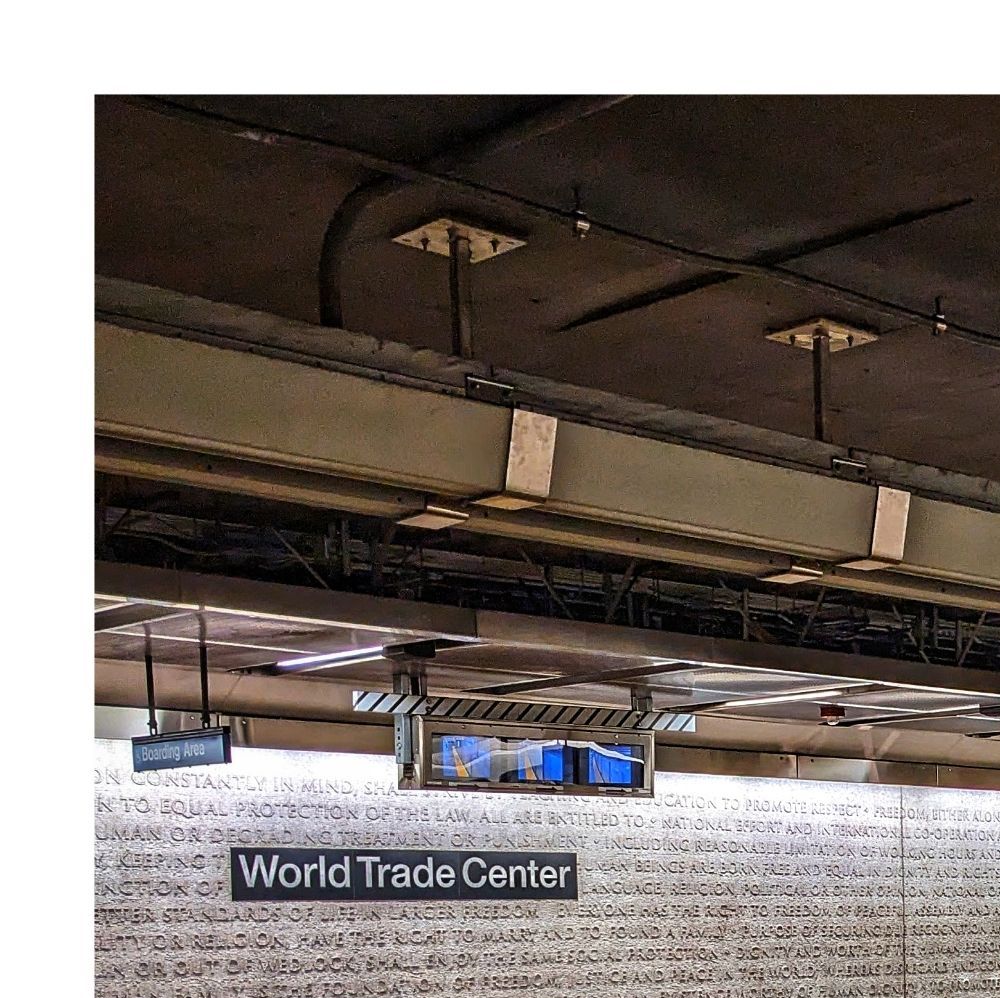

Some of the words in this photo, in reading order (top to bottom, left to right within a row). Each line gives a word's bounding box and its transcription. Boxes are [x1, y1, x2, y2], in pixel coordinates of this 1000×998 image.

[142, 746, 180, 761] Boarding
[184, 742, 205, 757] Area
[131, 770, 262, 791] CONSTANTLY
[274, 777, 295, 793] IN
[724, 799, 739, 812] TO
[746, 800, 806, 814] PROMOTE
[812, 803, 861, 817] RESPECT
[932, 808, 968, 821] EITHER
[120, 797, 150, 813] TO
[159, 798, 227, 819] EQUAL
[235, 802, 358, 820] PROTECTION
[367, 807, 389, 821] OF
[390, 807, 429, 823] THE
[479, 811, 508, 825] ALL
[516, 812, 542, 826] ARE
[549, 814, 618, 829] ENTITLED
[662, 818, 731, 832] NATIONAL
[736, 821, 782, 834] EFFORT
[786, 822, 811, 835] AND
[171, 826, 203, 842] OR
[208, 827, 332, 845] DEGRADING
[337, 831, 444, 847] TREATMENT
[450, 834, 476, 848] OR
[482, 835, 587, 851] PUNISHMENT
[605, 838, 689, 853] INCLUDING
[695, 841, 780, 855] REASONABLE
[239, 854, 351, 889] World
[356, 855, 456, 889] Trade
[462, 857, 571, 889] Center
[634, 861, 685, 874] BEINGS
[690, 862, 714, 875] ARE
[762, 863, 790, 876] FREE
[794, 864, 819, 876] AND
